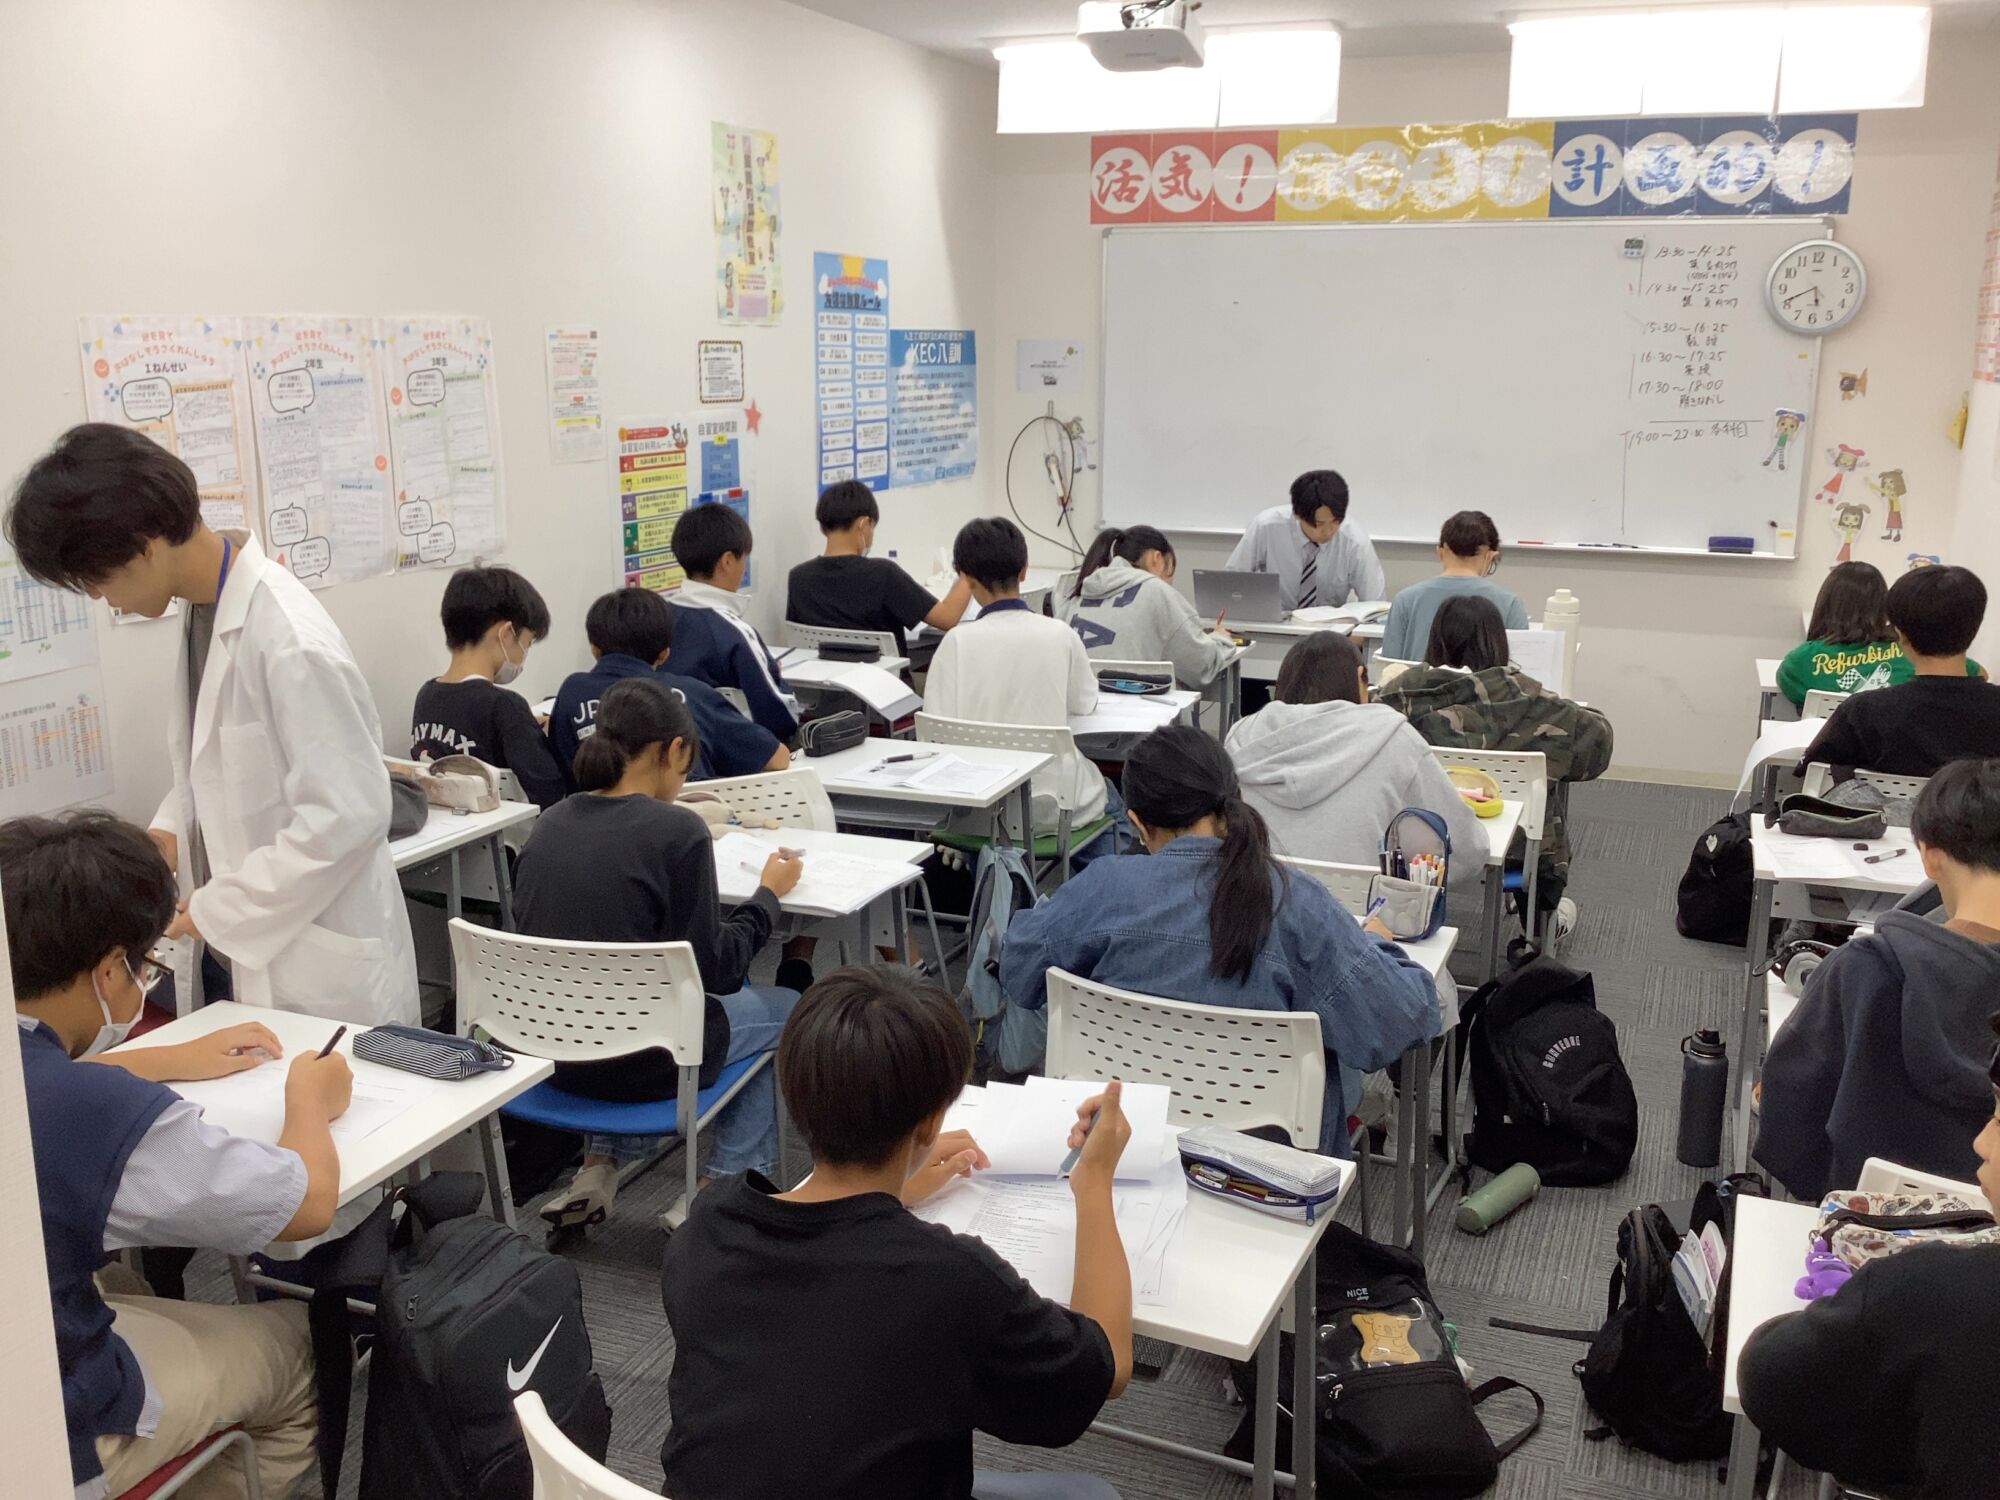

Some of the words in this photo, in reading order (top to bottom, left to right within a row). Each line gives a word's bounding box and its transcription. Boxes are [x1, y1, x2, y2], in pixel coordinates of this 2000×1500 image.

[1096, 150, 1254, 205] 活気！
[1797, 255, 1807, 267] 11
[1812, 251, 1825, 264] 12
[1832, 255, 1838, 267] 1
[1784, 267, 1797, 279] 10
[1841, 266, 1850, 279] 2
[1778, 283, 1788, 295] 9
[1844, 282, 1854, 294] 3
[1837, 297, 1846, 309] 4
[1793, 309, 1802, 321] 7
[1807, 312, 1817, 325] 6
[1824, 309, 1834, 321] 5
[1812, 642, 1903, 676] Refurbish
[1346, 1287, 1369, 1298] NICE
